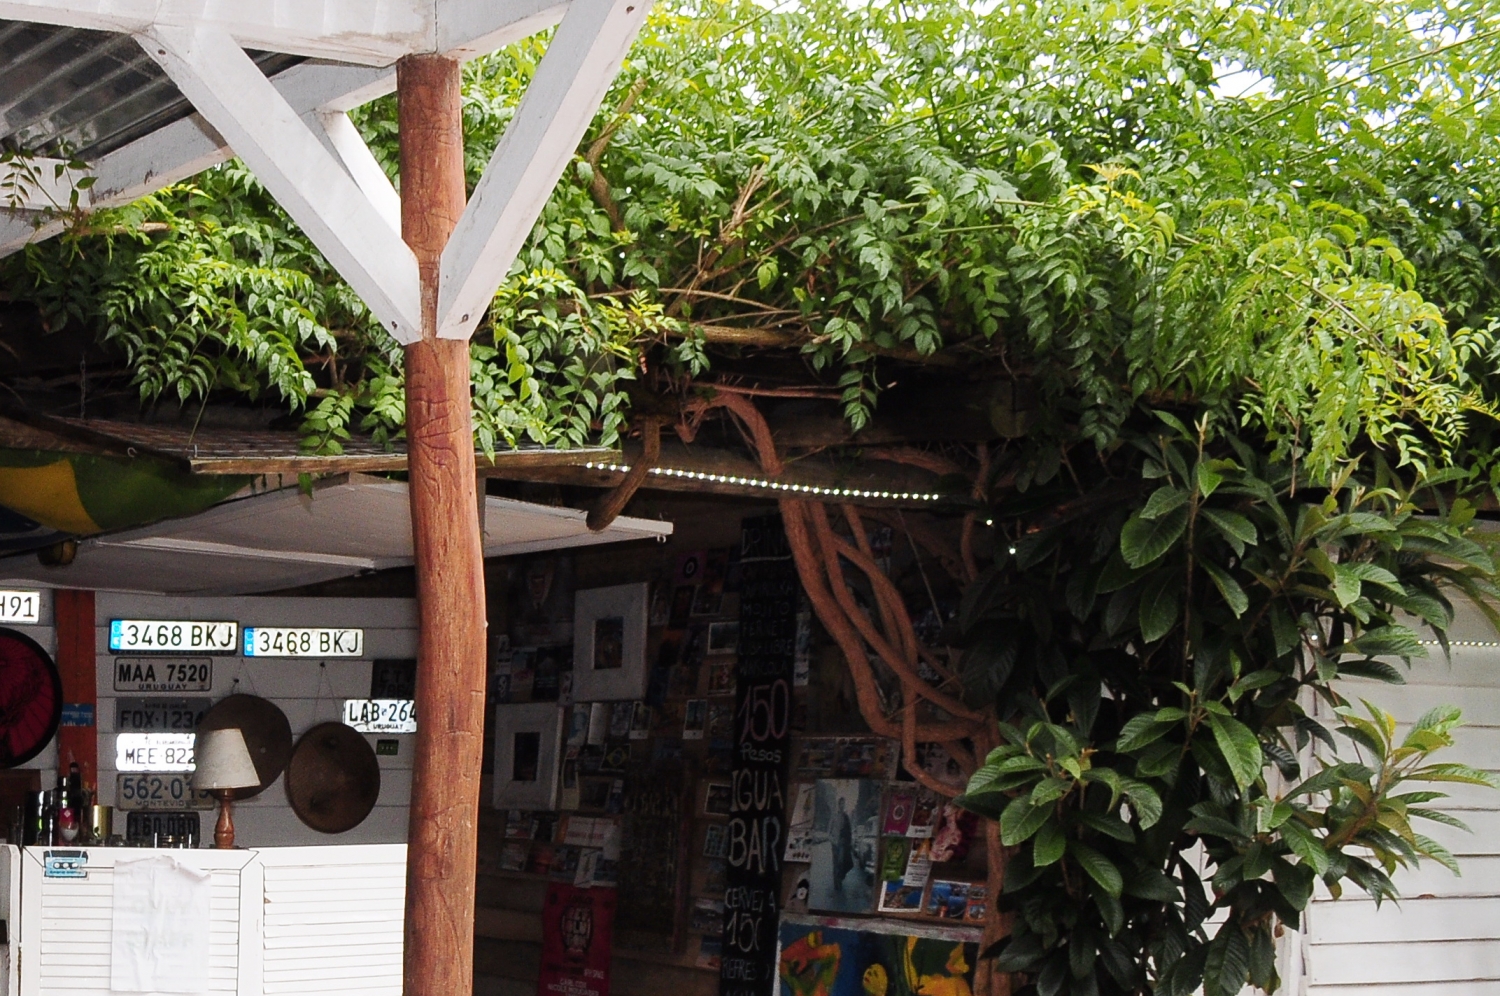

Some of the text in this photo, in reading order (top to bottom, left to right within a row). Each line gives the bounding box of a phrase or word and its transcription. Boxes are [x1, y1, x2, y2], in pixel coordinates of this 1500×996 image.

[126, 624, 182, 646] 3468
[190, 625, 233, 647] BKJ
[259, 631, 311, 652] 3468
[319, 632, 359, 653] BKJ
[118, 664, 208, 683] MAA 7520
[737, 678, 790, 746] 150
[739, 741, 783, 764] Pesos
[729, 768, 784, 813] IGUA
[728, 816, 782, 875] BAR
